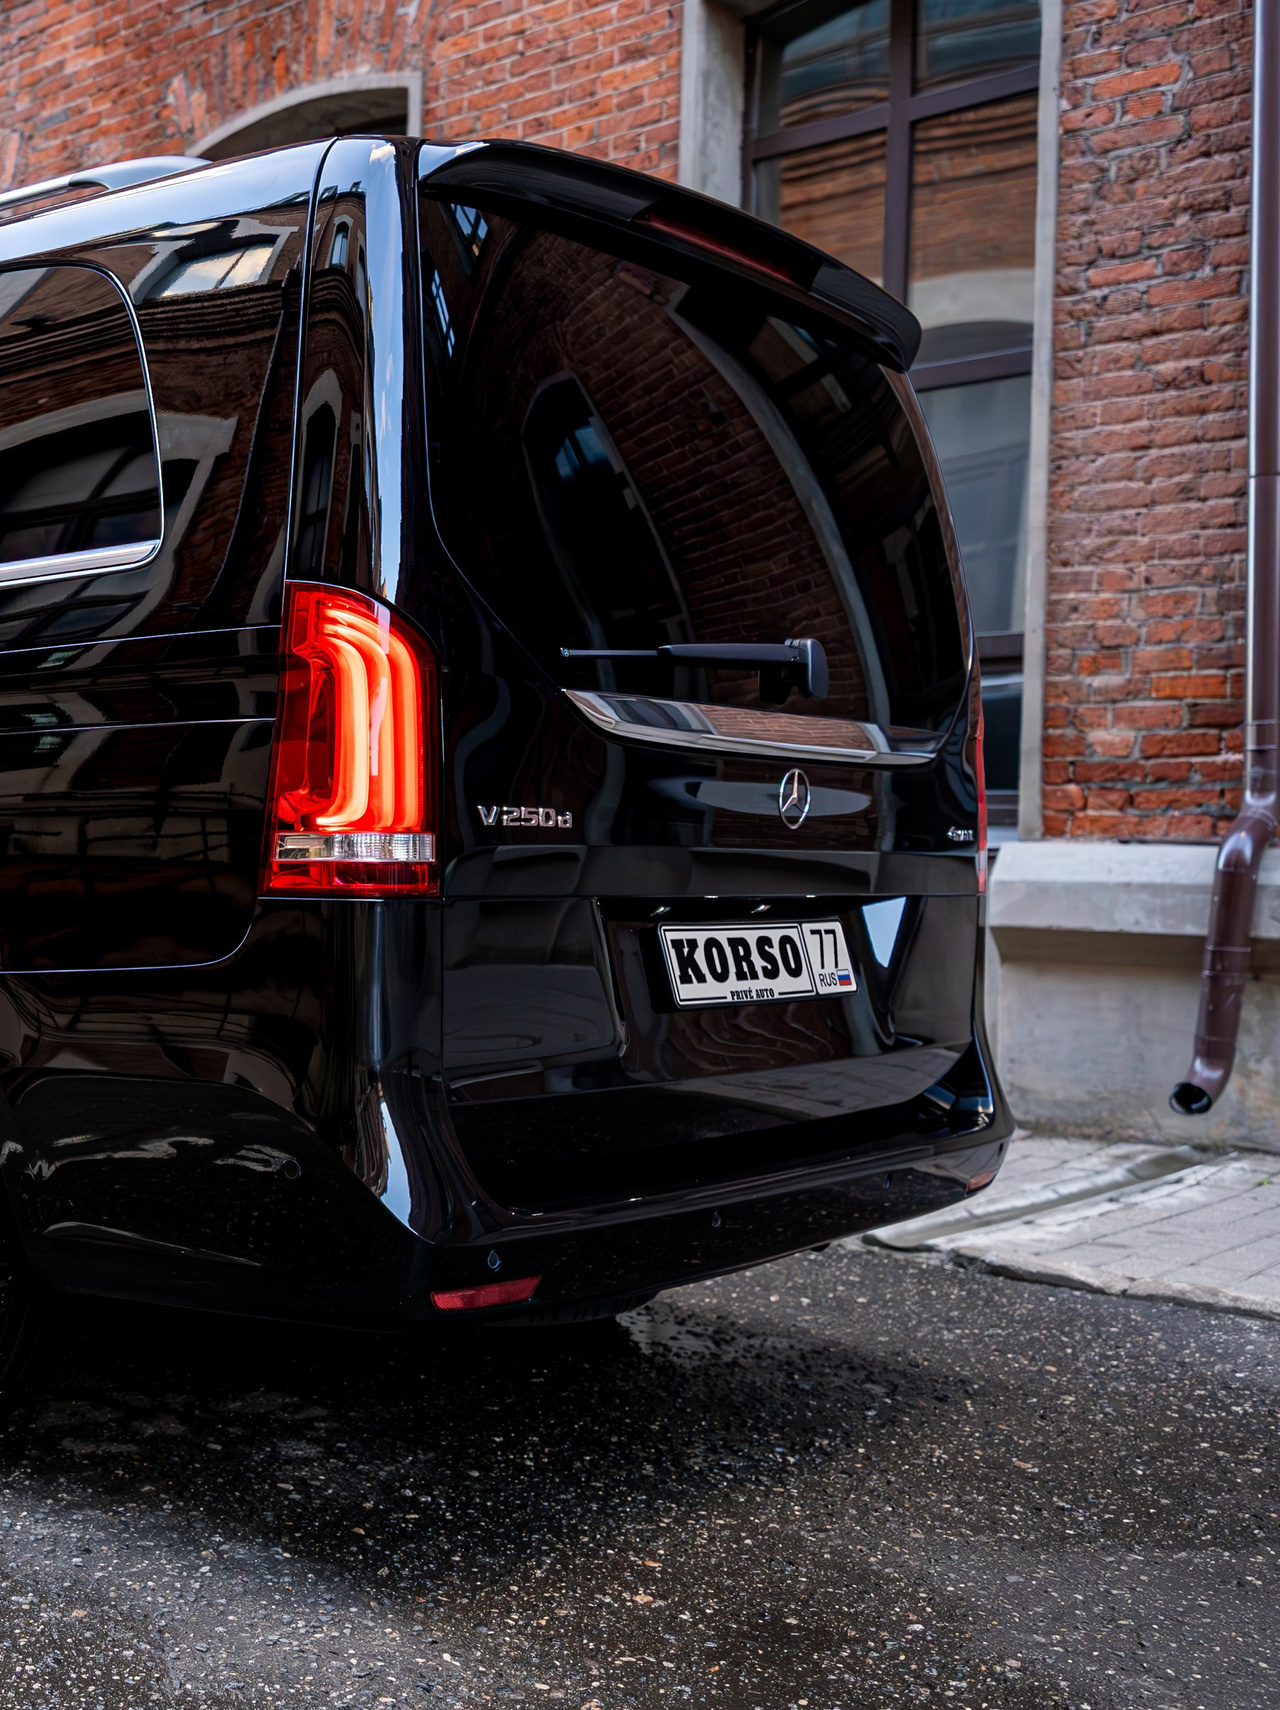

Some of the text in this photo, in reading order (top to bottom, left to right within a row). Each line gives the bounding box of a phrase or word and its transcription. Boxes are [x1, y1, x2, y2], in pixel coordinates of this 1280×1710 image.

[670, 934, 803, 985] KORSO
[810, 929, 839, 970] 77
[730, 986, 776, 1001] PRIVÉ AUTO
[818, 972, 838, 988] RUS
